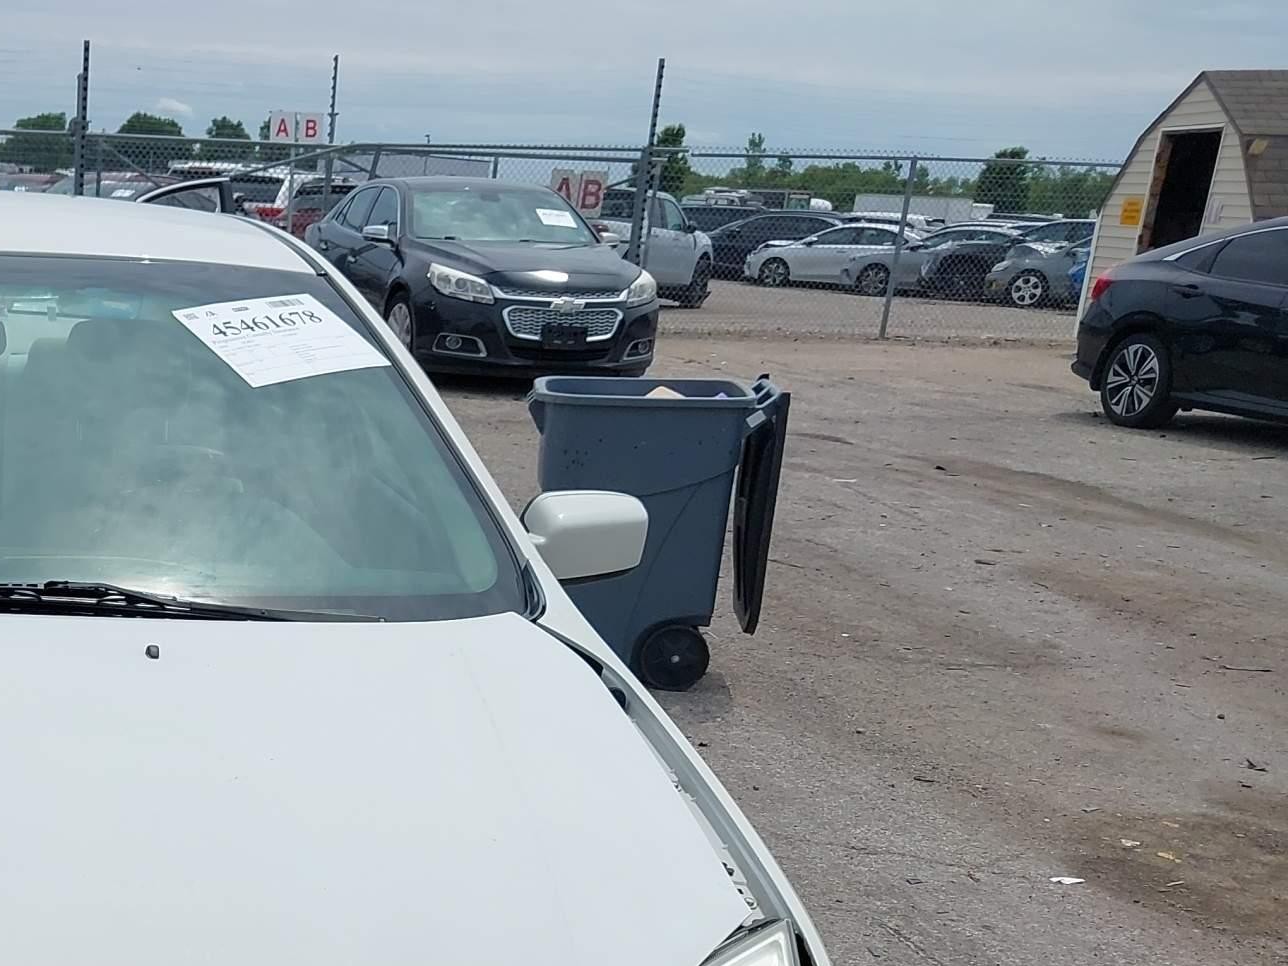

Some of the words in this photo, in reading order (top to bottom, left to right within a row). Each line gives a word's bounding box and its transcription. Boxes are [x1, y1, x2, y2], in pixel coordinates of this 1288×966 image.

[275, 118, 289, 137] A
[305, 120, 318, 138] B
[556, 176, 573, 202] A
[580, 179, 602, 210] B
[211, 310, 323, 337] 45461678
